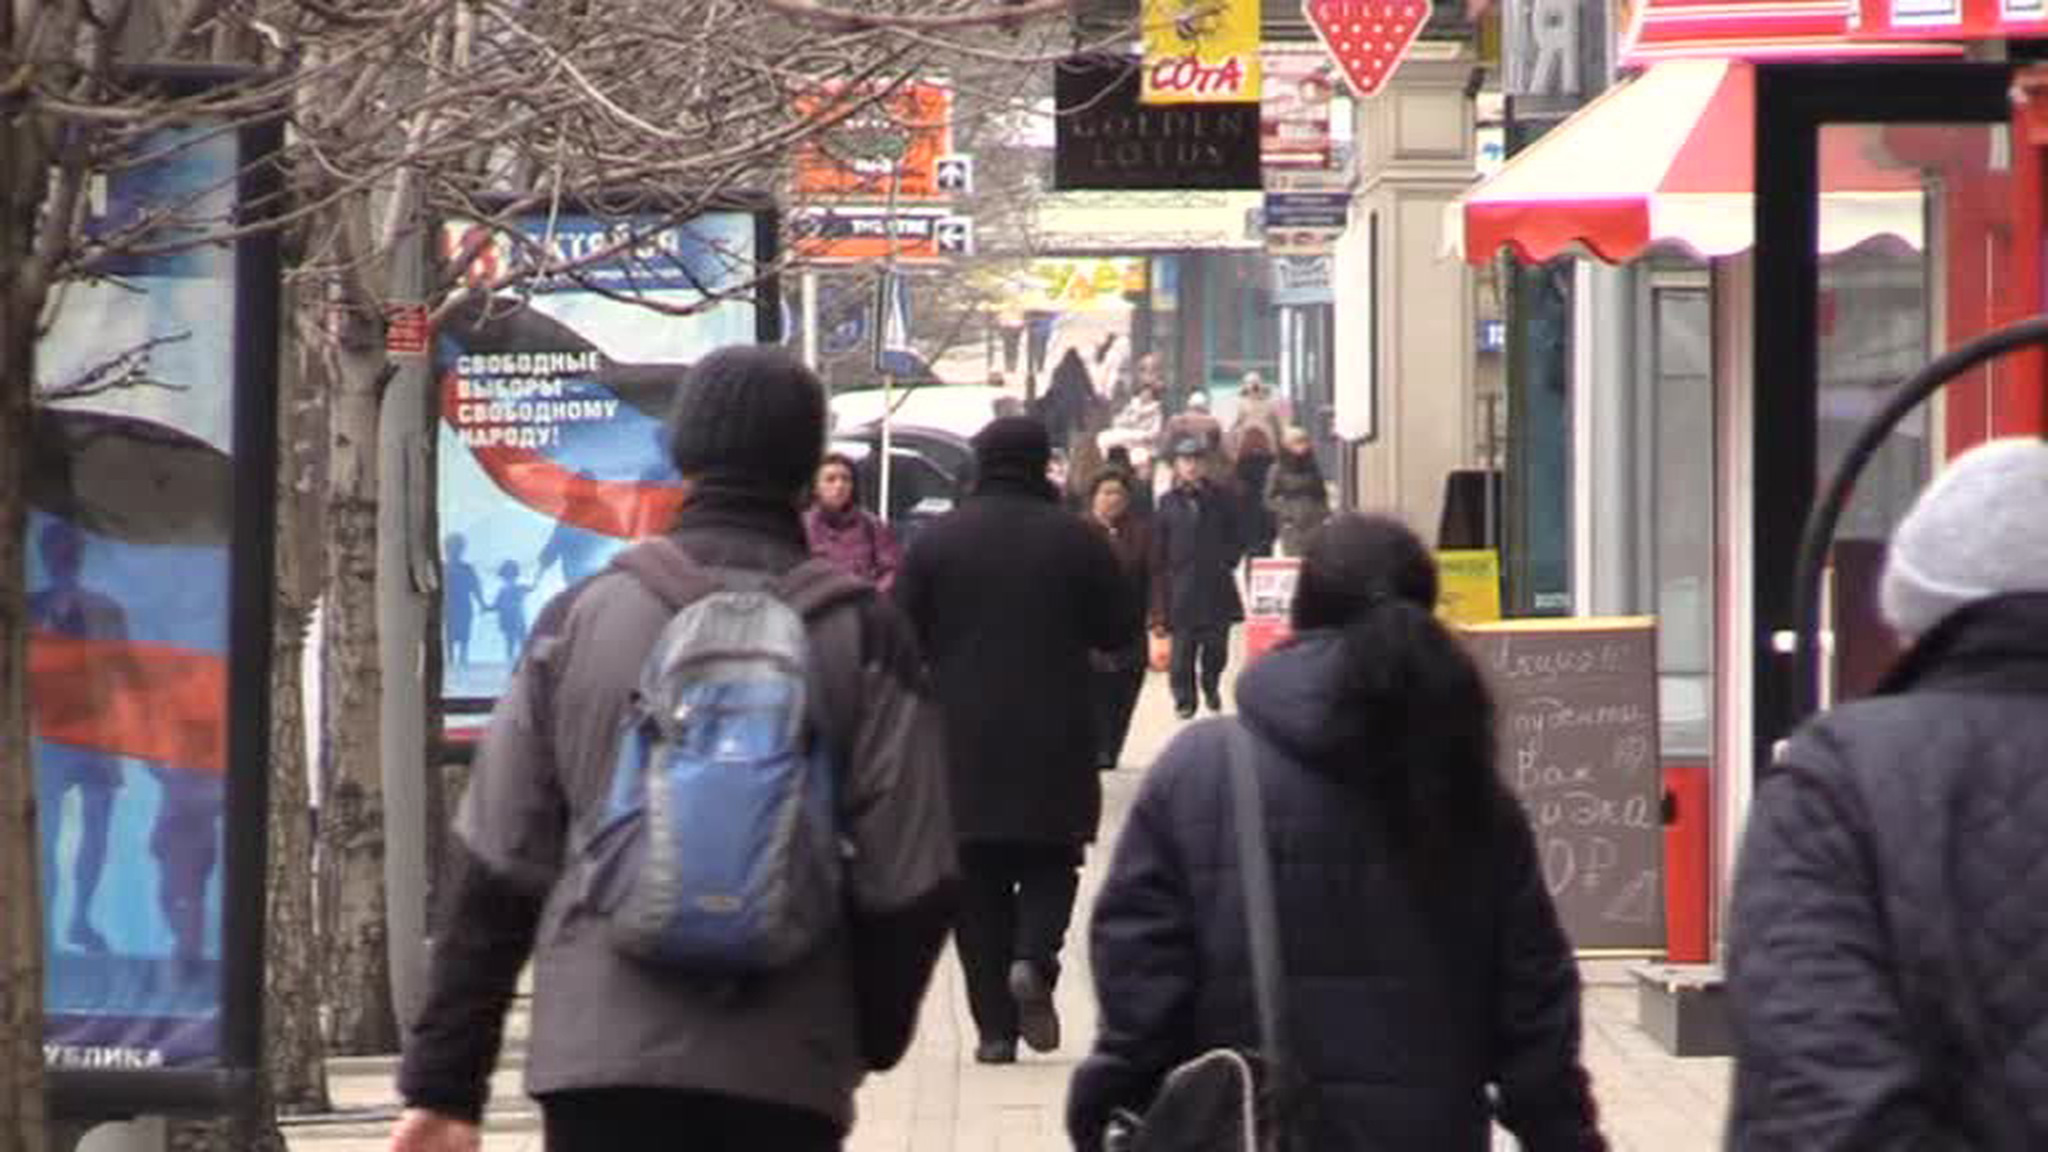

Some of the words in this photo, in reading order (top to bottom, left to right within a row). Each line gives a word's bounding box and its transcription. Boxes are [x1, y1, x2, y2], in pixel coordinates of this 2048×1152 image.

[456, 351, 600, 376] СВОБОДНЫЕ
[456, 378, 562, 400] ВЫБОРЫ
[456, 400, 619, 423] СВОБОДНОМУ
[43, 1043, 163, 1070] УБЛИКА
